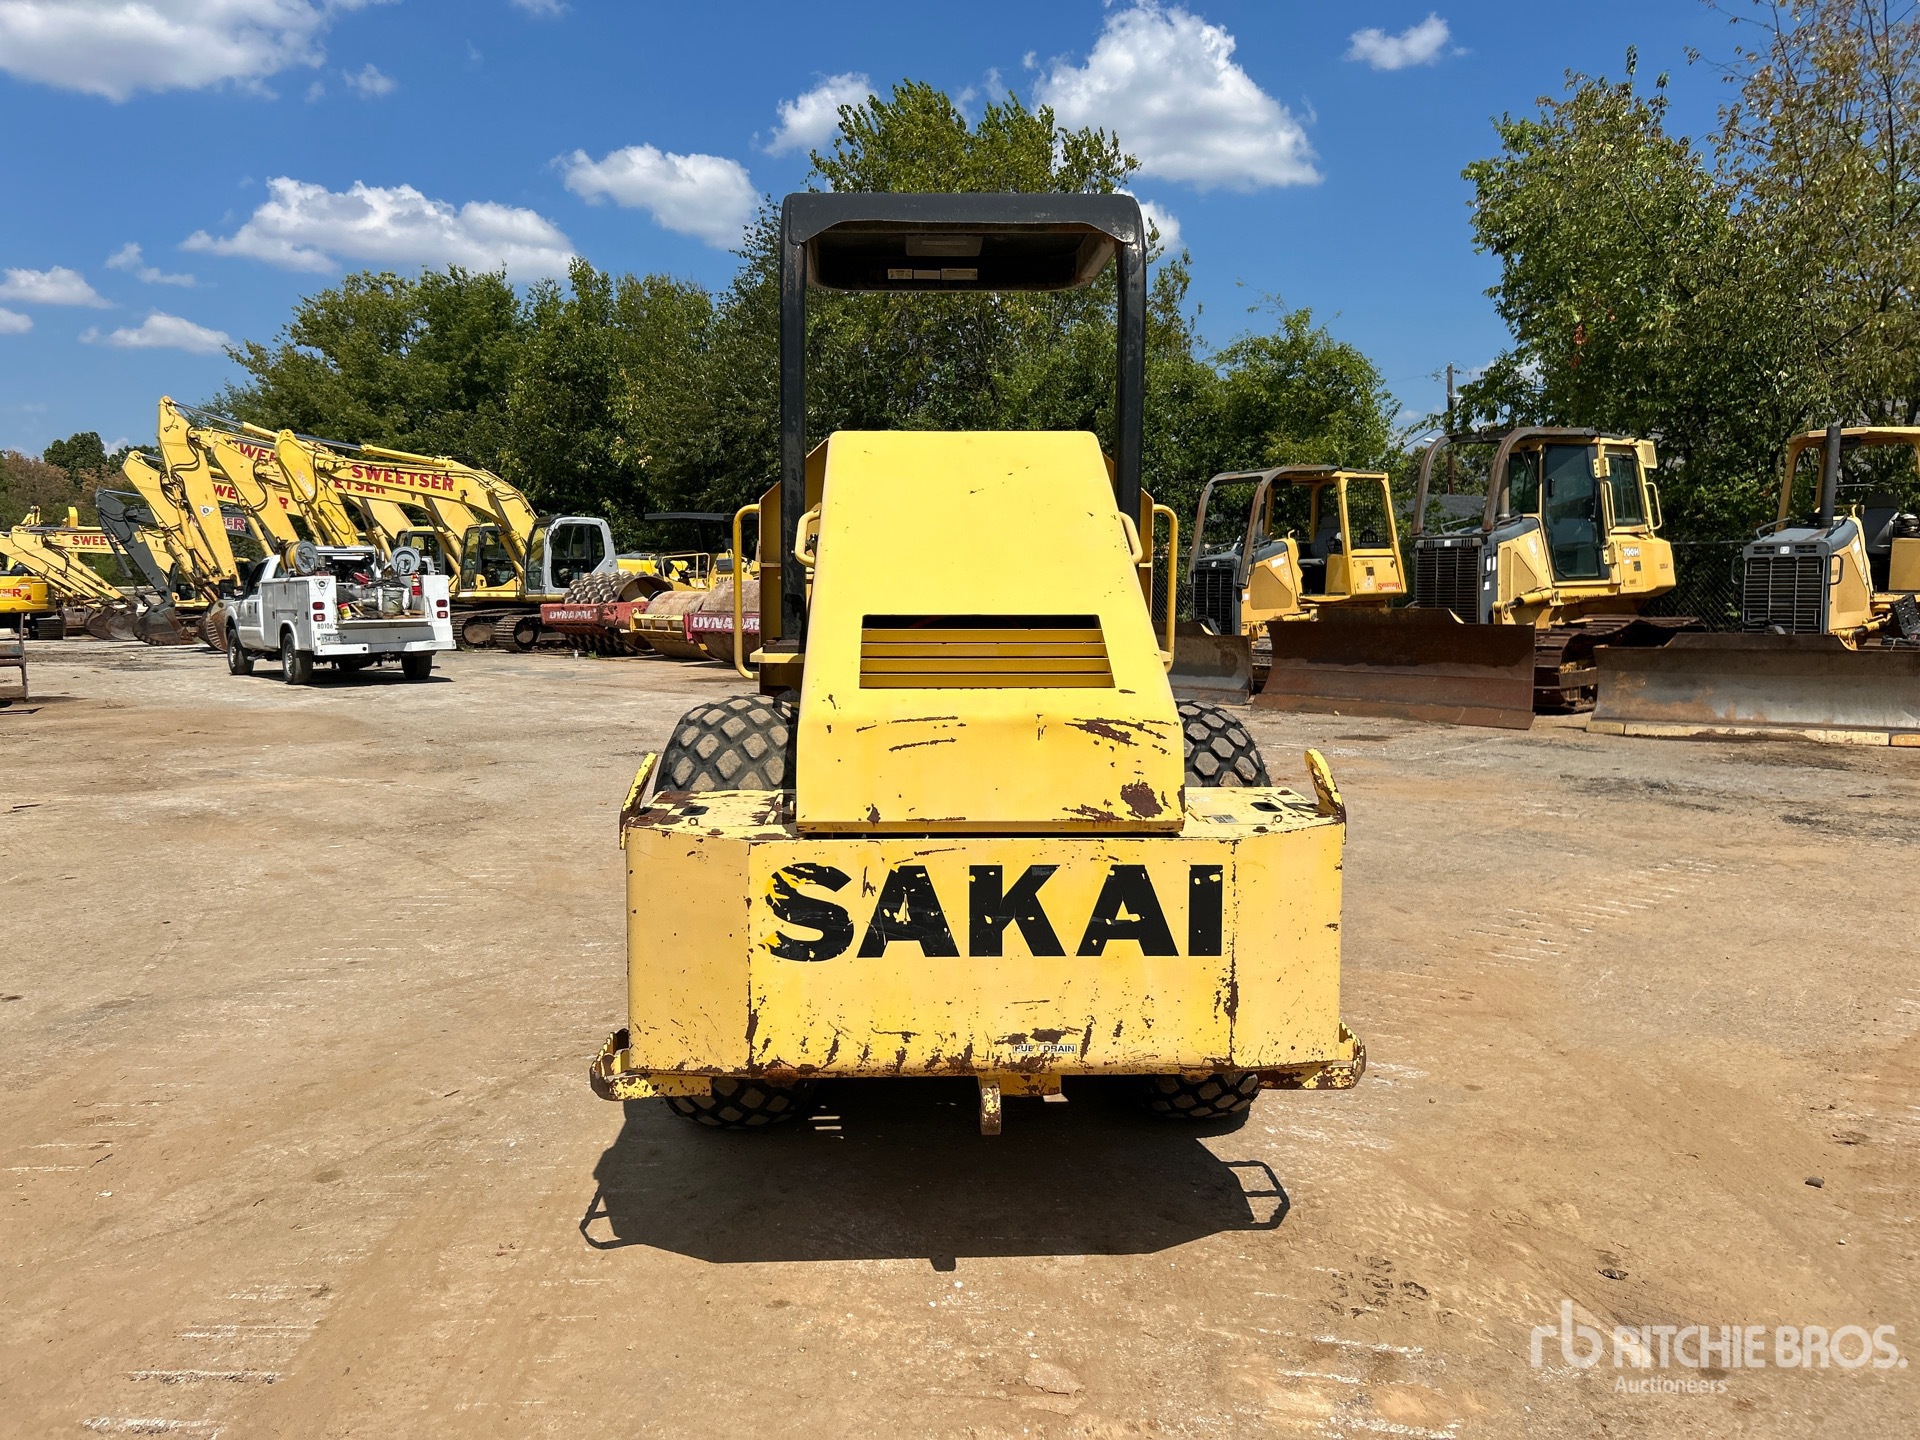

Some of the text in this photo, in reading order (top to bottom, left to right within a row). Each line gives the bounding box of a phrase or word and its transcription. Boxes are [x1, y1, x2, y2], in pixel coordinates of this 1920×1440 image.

[351, 464, 454, 492] SWEETSER
[761, 862, 1223, 962] SAKAI
[1014, 1044, 1075, 1053] FUE DRAIN
